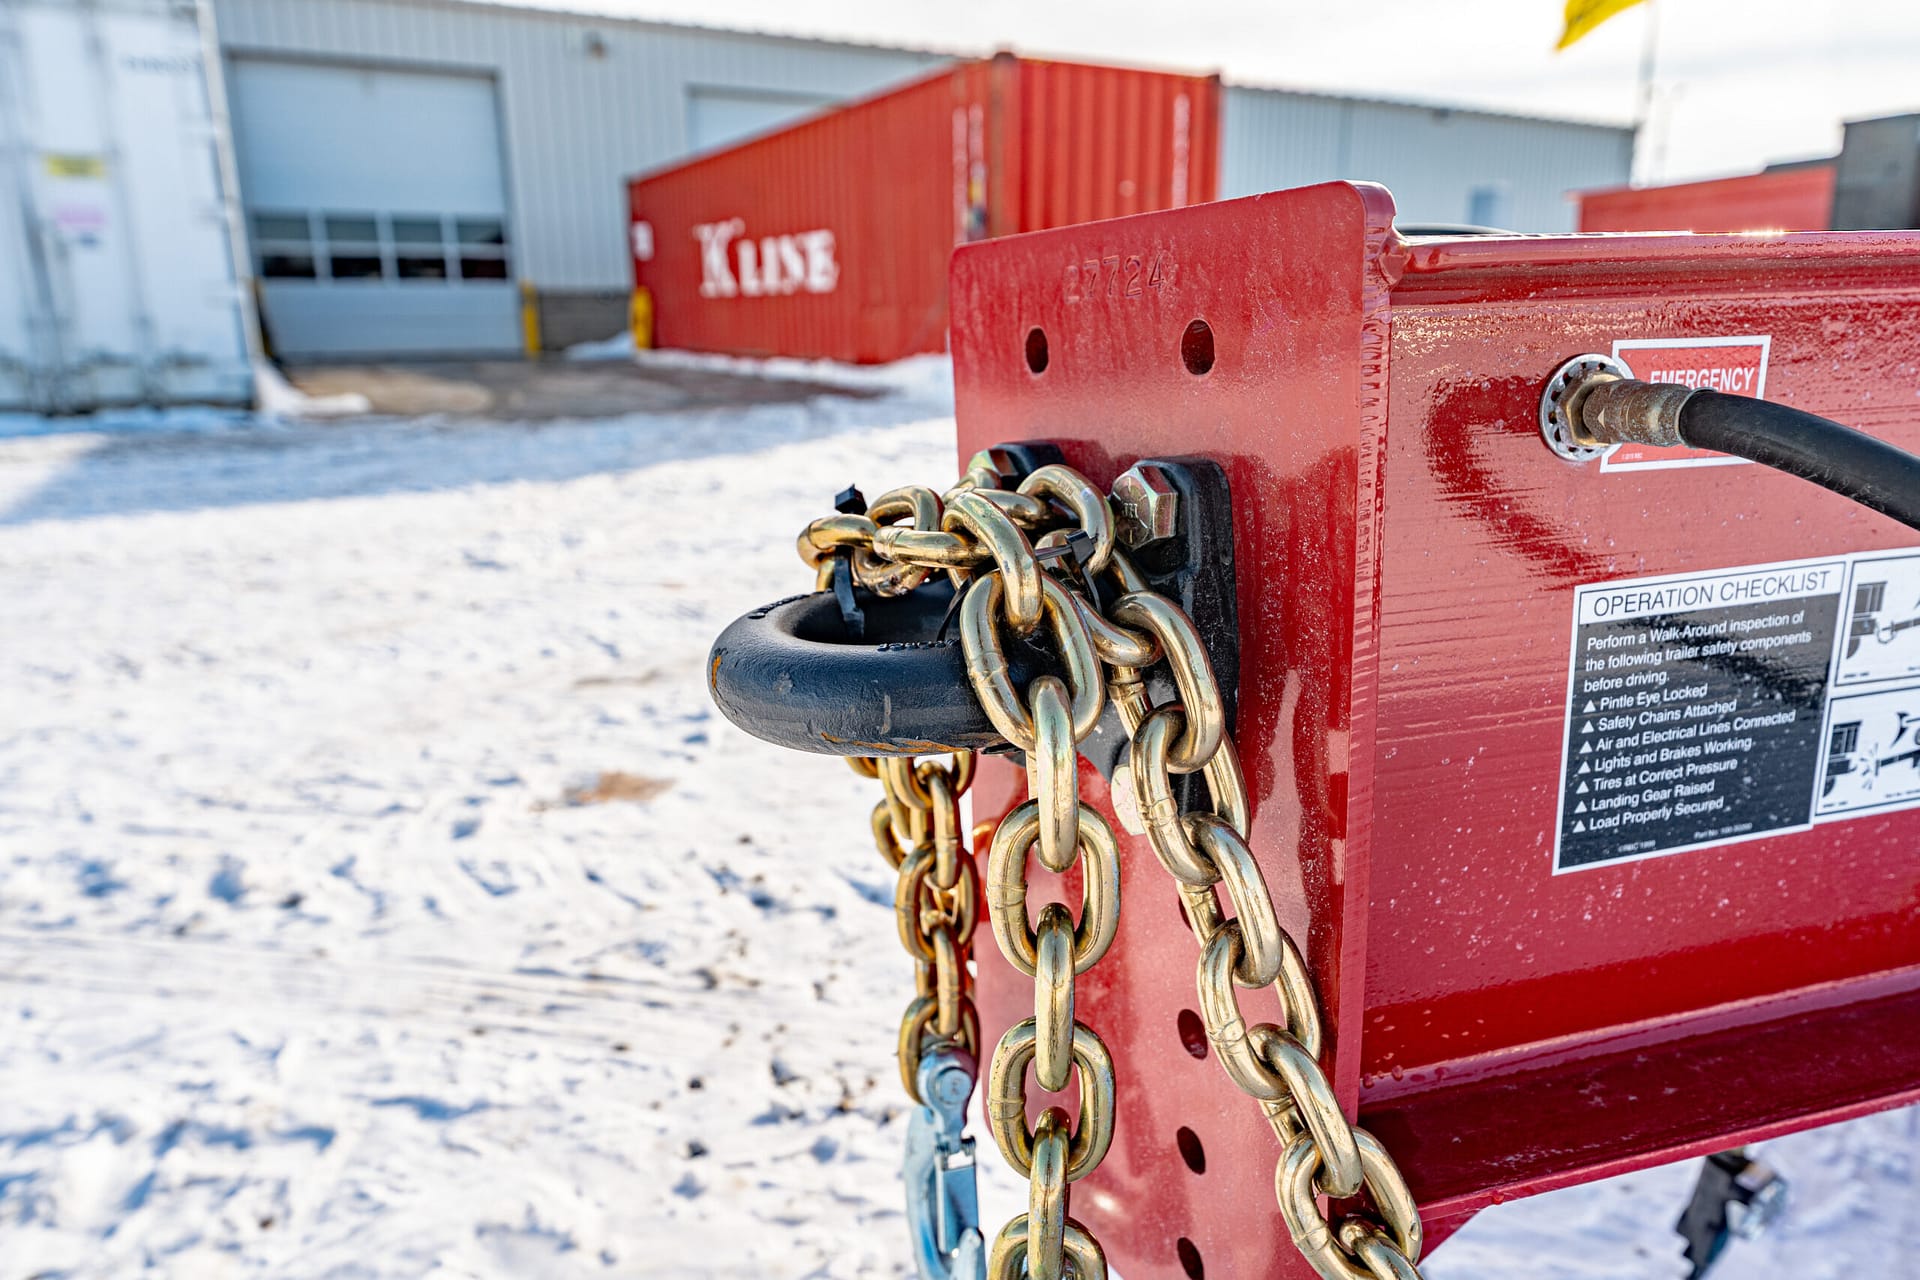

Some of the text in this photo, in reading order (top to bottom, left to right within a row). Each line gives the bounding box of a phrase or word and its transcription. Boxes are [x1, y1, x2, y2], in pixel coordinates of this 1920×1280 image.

[1063, 254, 1164, 304] 27724
[1650, 367, 1755, 392] EMERGENCY
[1593, 570, 1831, 617] OPERATION CHECKLIST
[1587, 610, 1805, 651] Perform a Walk-Around inspection of
[1585, 630, 1812, 672] the following trailer safety components
[1584, 669, 1670, 693] before driving.
[1600, 683, 1708, 711] Pintle Eye Locked
[1596, 709, 1797, 752] Air and Electrical Lines Connected
[1598, 699, 1737, 732] Safety Chains Attached
[1593, 757, 1738, 792] Tires at Correct Pressure
[1594, 755, 1632, 774] Lights
[1633, 750, 1657, 766] and
[1660, 743, 1701, 763] Brakes
[1591, 778, 1715, 813] Landing Gear Raised
[1589, 796, 1724, 831] Load Properly Secured
